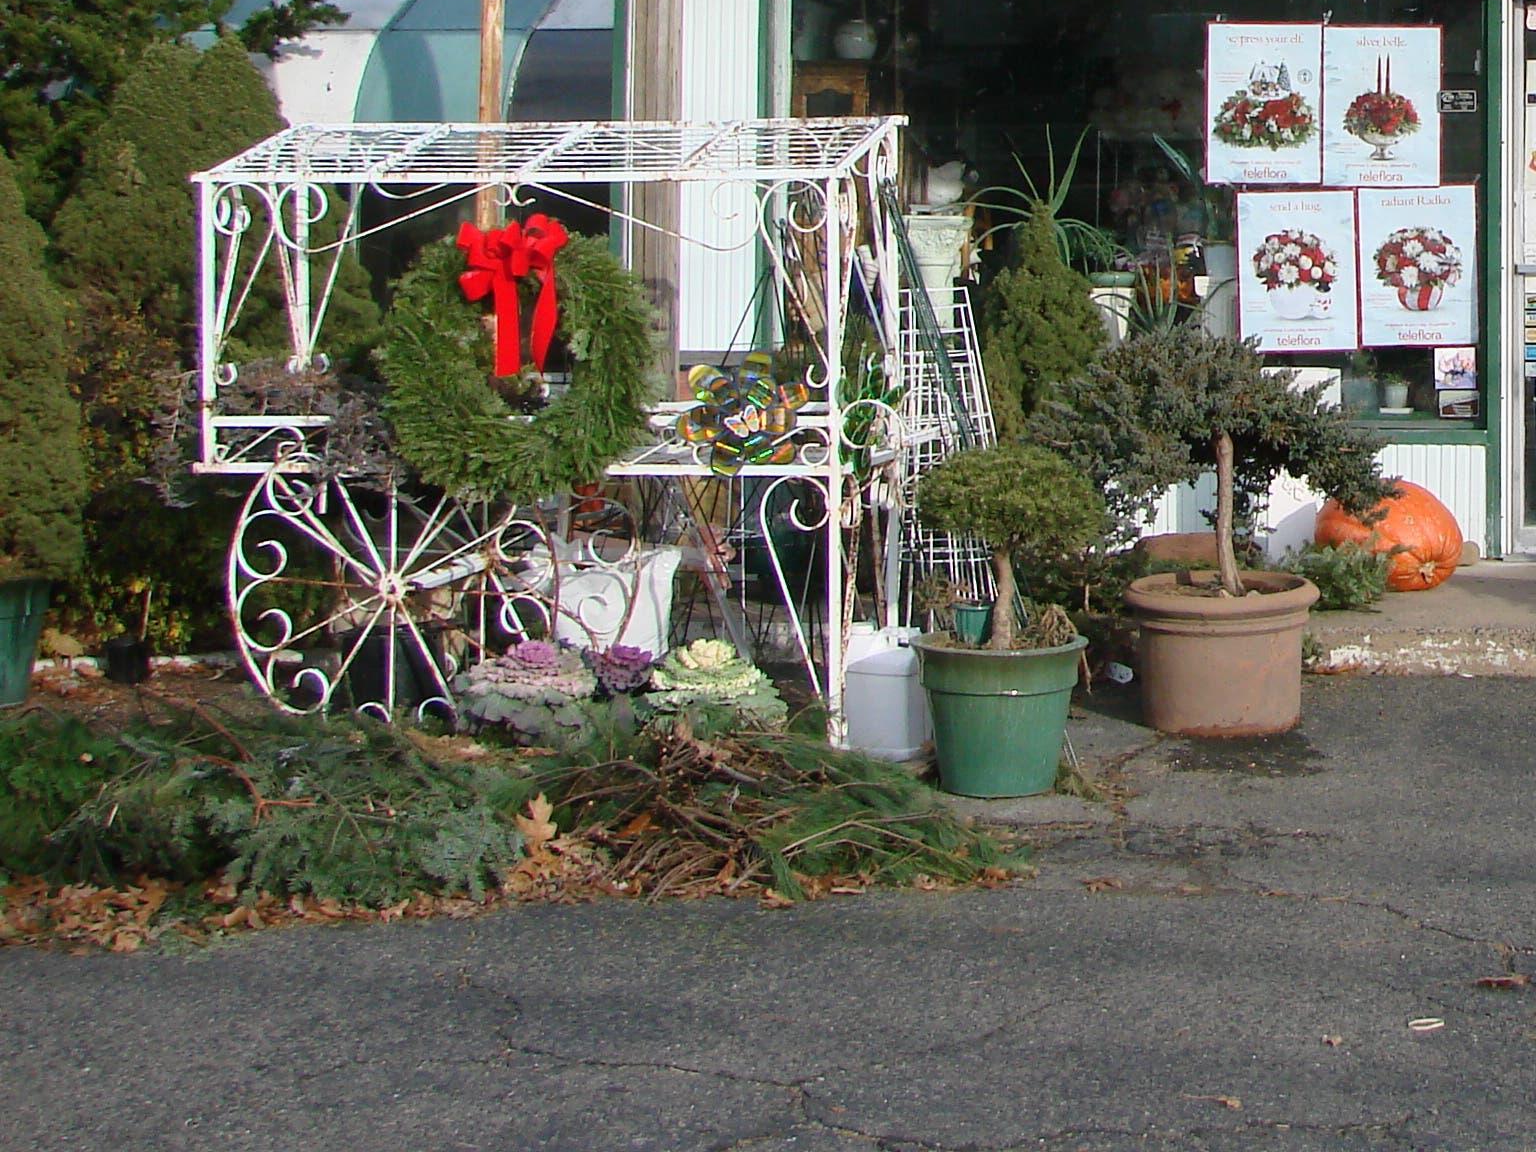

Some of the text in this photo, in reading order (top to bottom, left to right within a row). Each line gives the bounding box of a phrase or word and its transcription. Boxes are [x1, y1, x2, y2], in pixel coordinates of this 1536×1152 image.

[1355, 36, 1380, 47] silver
[1243, 167, 1287, 179] teleflora
[1359, 170, 1403, 182] teleflora
[1381, 196, 1414, 207] radiant
[1277, 334, 1321, 346] teleflora
[1398, 330, 1442, 341] teleflora
